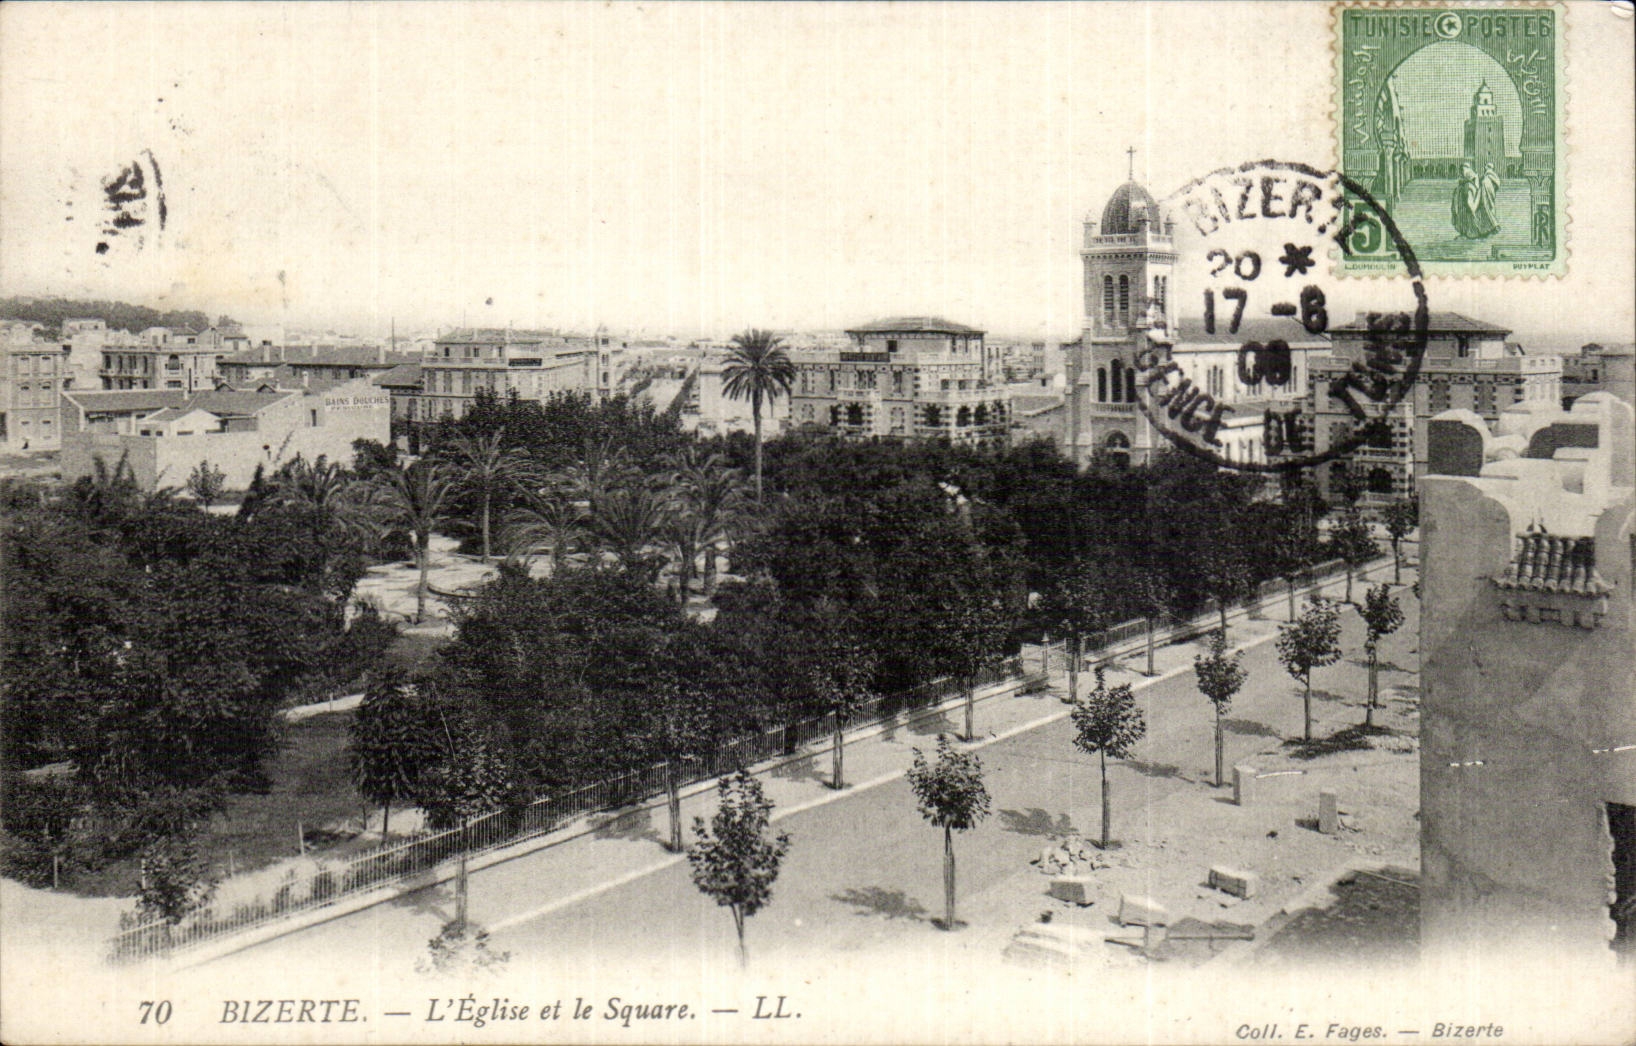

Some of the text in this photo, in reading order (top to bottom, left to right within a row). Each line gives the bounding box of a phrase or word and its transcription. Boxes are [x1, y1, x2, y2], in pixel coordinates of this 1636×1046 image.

[1350, 15, 1551, 38] TUNISIE POSTES
[1351, 202, 1382, 254] 5
[1203, 287, 1248, 335] 17
